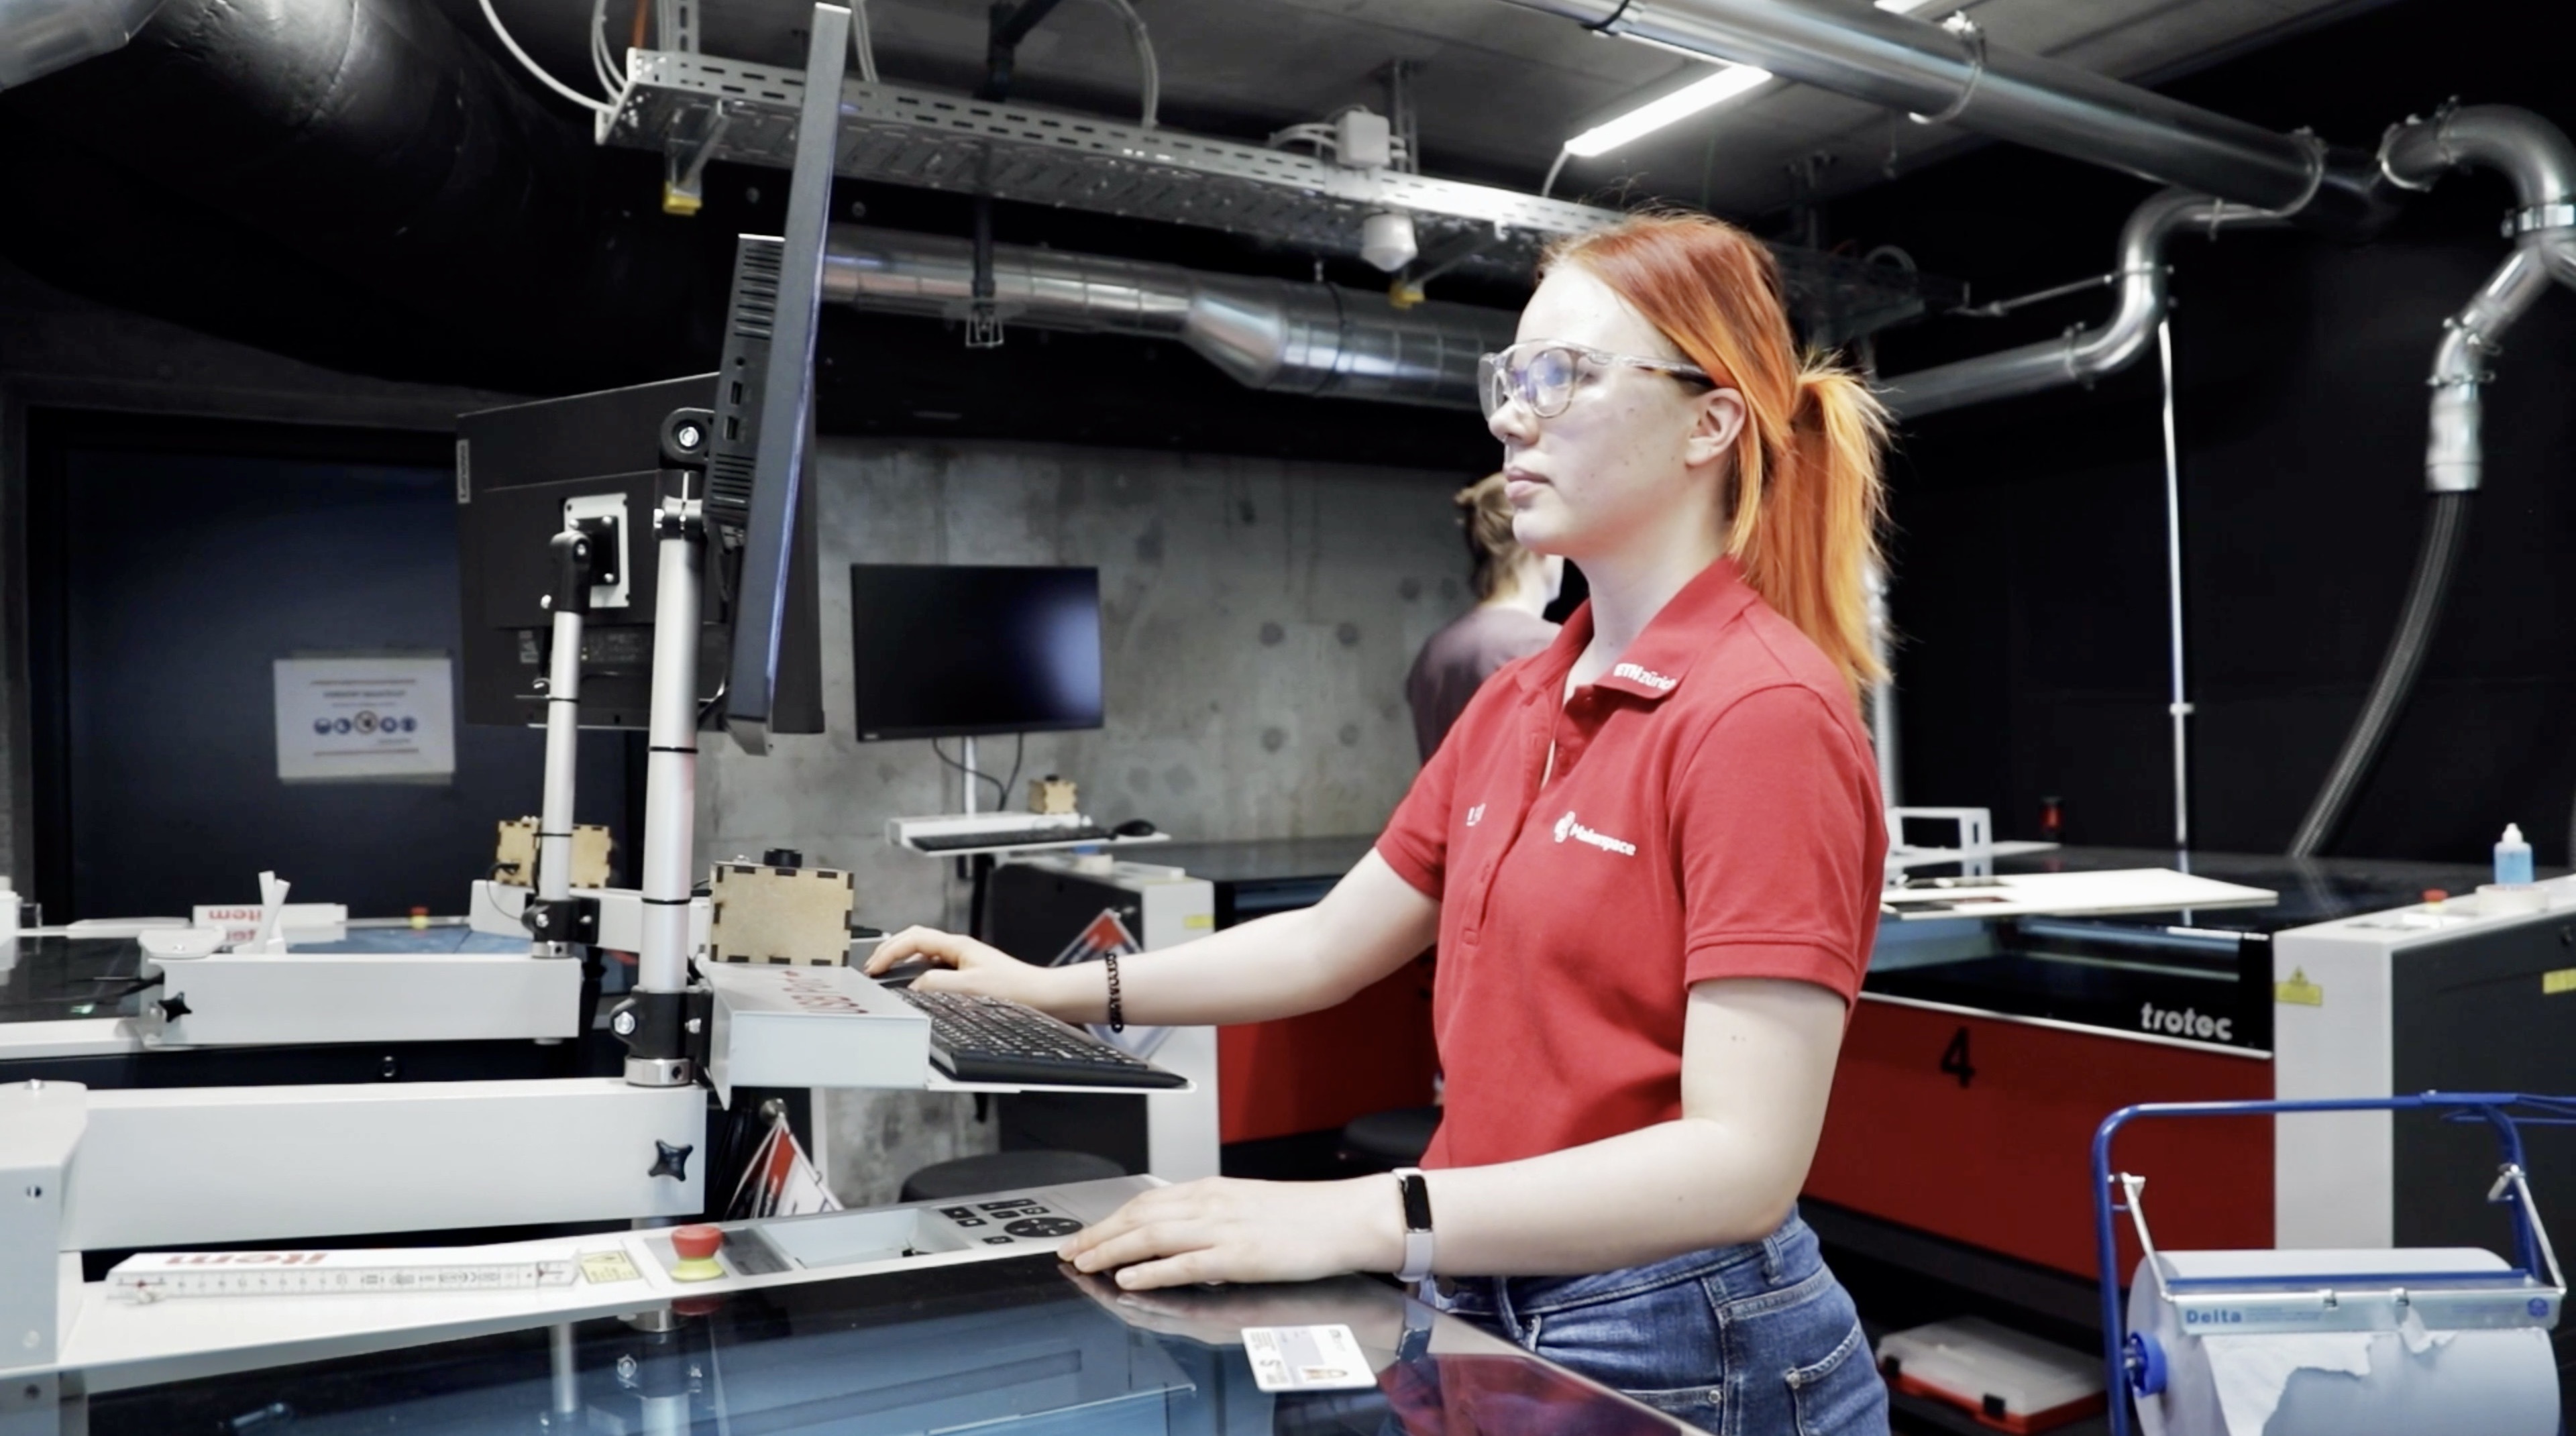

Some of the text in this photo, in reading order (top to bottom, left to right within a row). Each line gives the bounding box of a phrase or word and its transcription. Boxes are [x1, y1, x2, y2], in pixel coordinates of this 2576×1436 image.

[2141, 1001, 2233, 1040] trotec
[1941, 1025, 1976, 1089] 4
[2186, 1309, 2242, 1325] Delta
